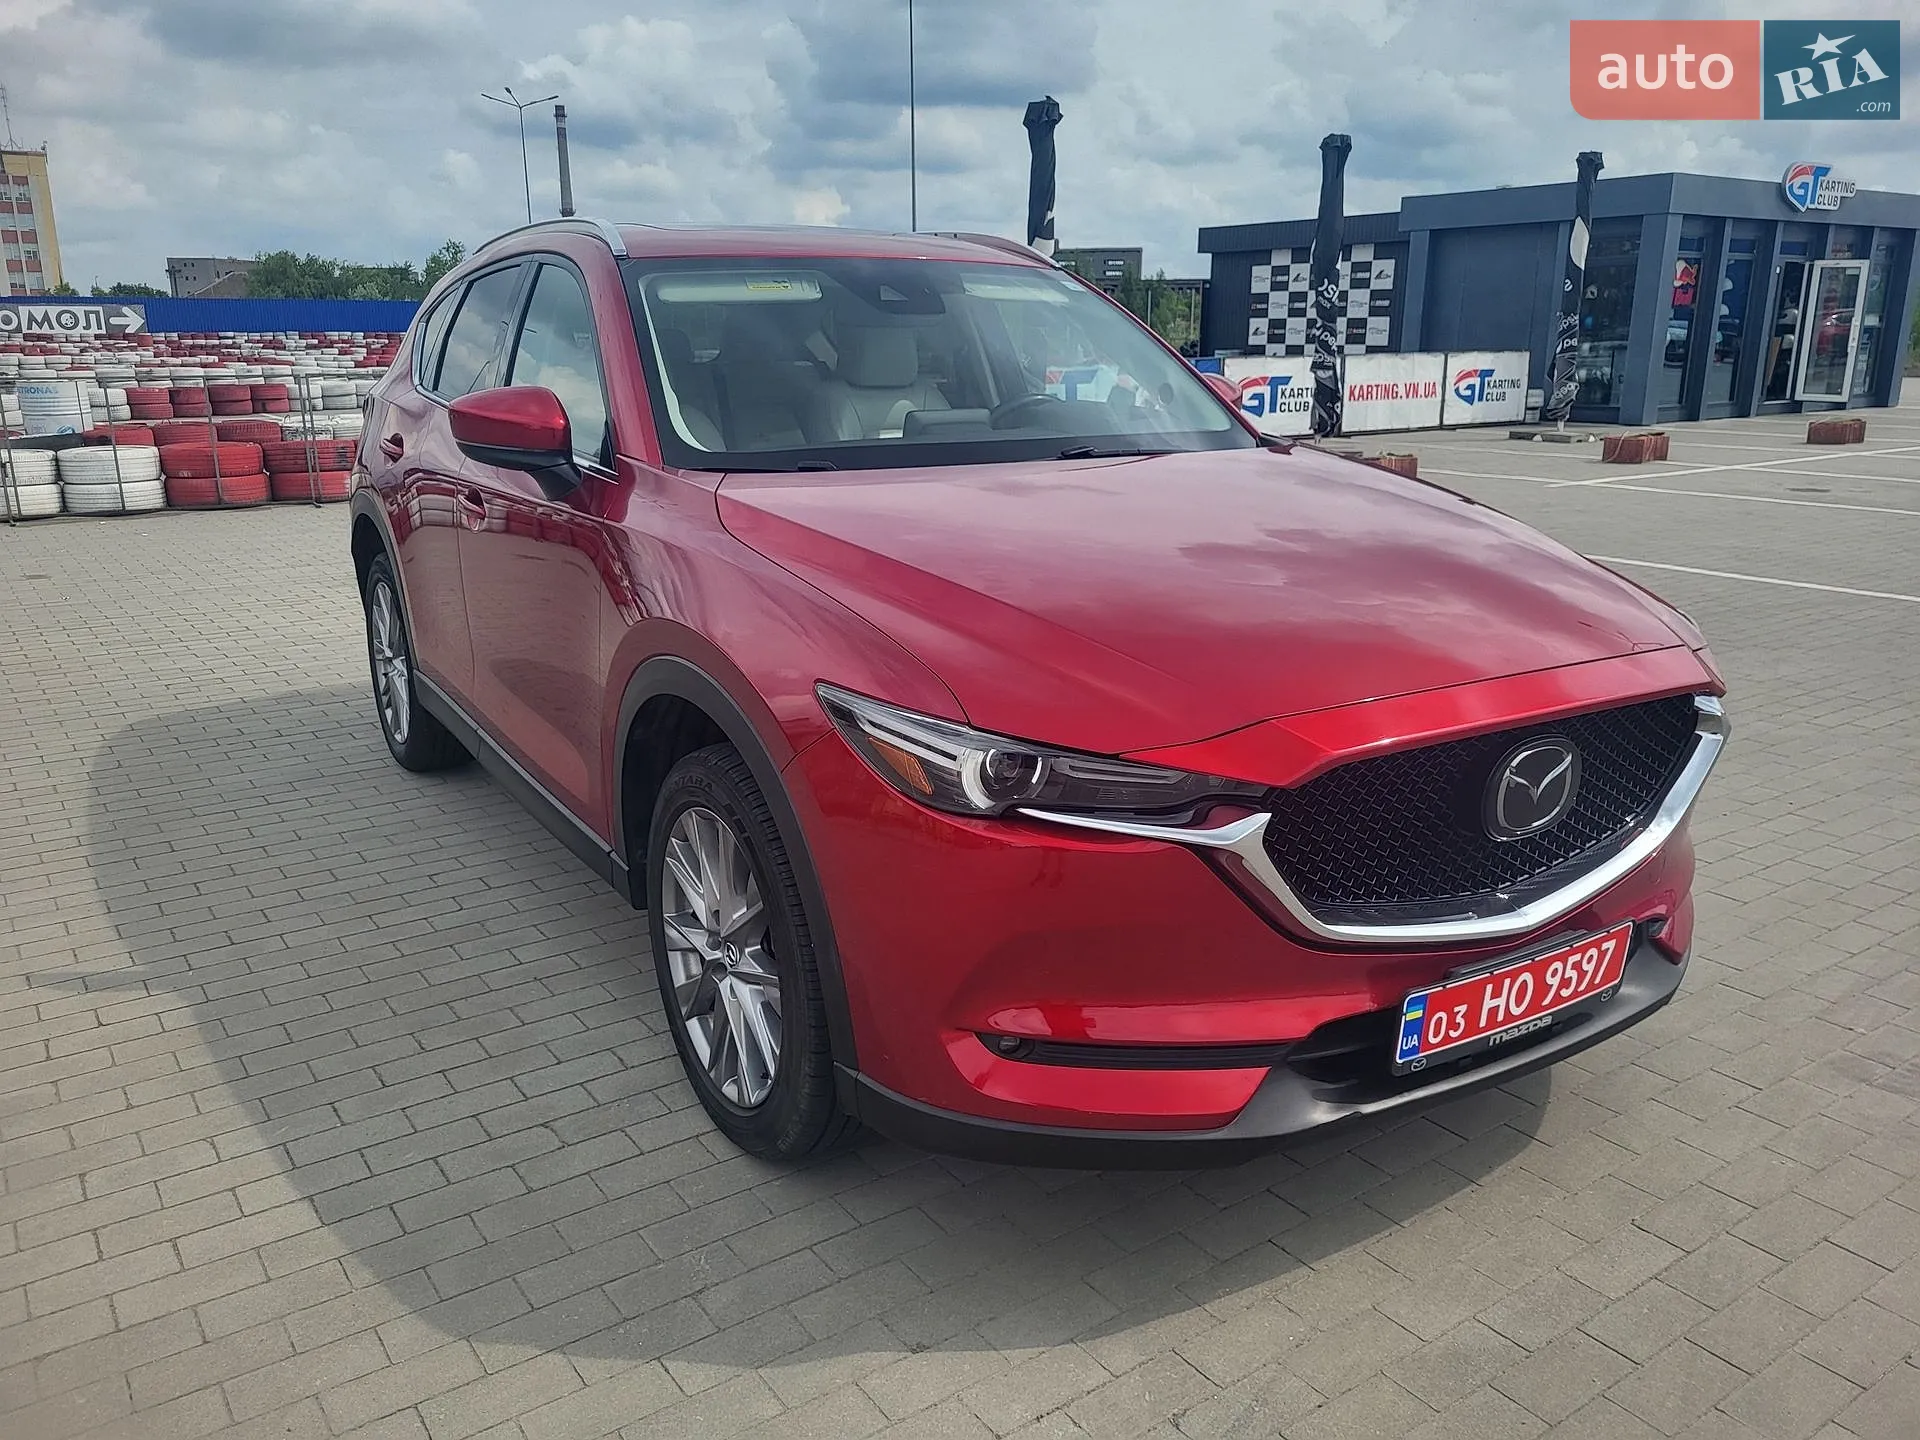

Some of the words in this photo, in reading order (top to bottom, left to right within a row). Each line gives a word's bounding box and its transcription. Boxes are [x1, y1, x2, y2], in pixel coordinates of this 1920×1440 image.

[1786, 165, 1831, 209] GT
[1819, 179, 1857, 195] KARTING
[1816, 194, 1840, 208] CLUB
[1348, 381, 1438, 402] KARTING.VN.UA
[1453, 368, 1496, 406] GT
[1486, 378, 1521, 390] KARTING
[1279, 386, 1314, 400] KARTI
[1484, 391, 1507, 402] CLUB
[1279, 399, 1311, 413] CLUB
[1427, 1003, 1469, 1045] 03
[1479, 971, 1534, 1030] HO
[1541, 939, 1617, 1006] 9597
[1402, 1033, 1419, 1050] UA
